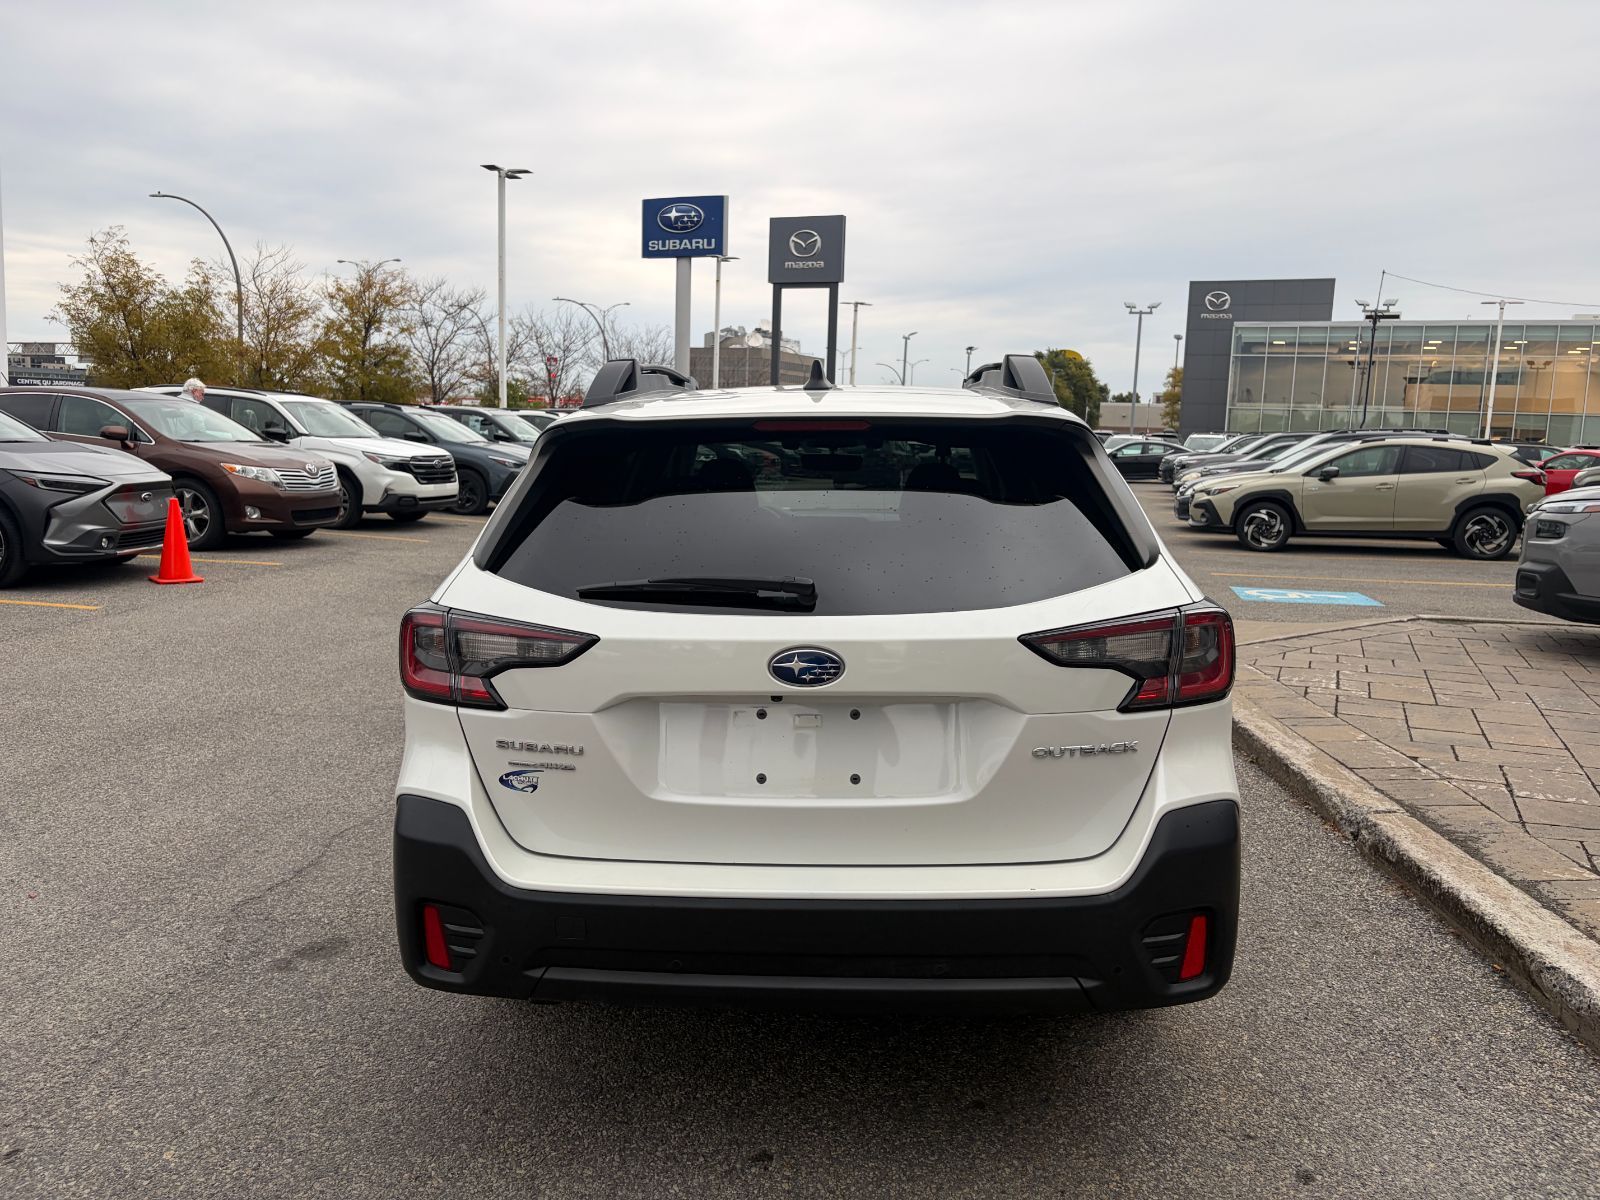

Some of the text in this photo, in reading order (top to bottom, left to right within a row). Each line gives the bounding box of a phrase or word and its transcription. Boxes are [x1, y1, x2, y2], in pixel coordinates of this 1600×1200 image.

[648, 238, 716, 251] SUBARU
[16, 378, 41, 386] CENTRE
[495, 739, 584, 756] SUBARU
[1031, 740, 1139, 759] OUTBACK
